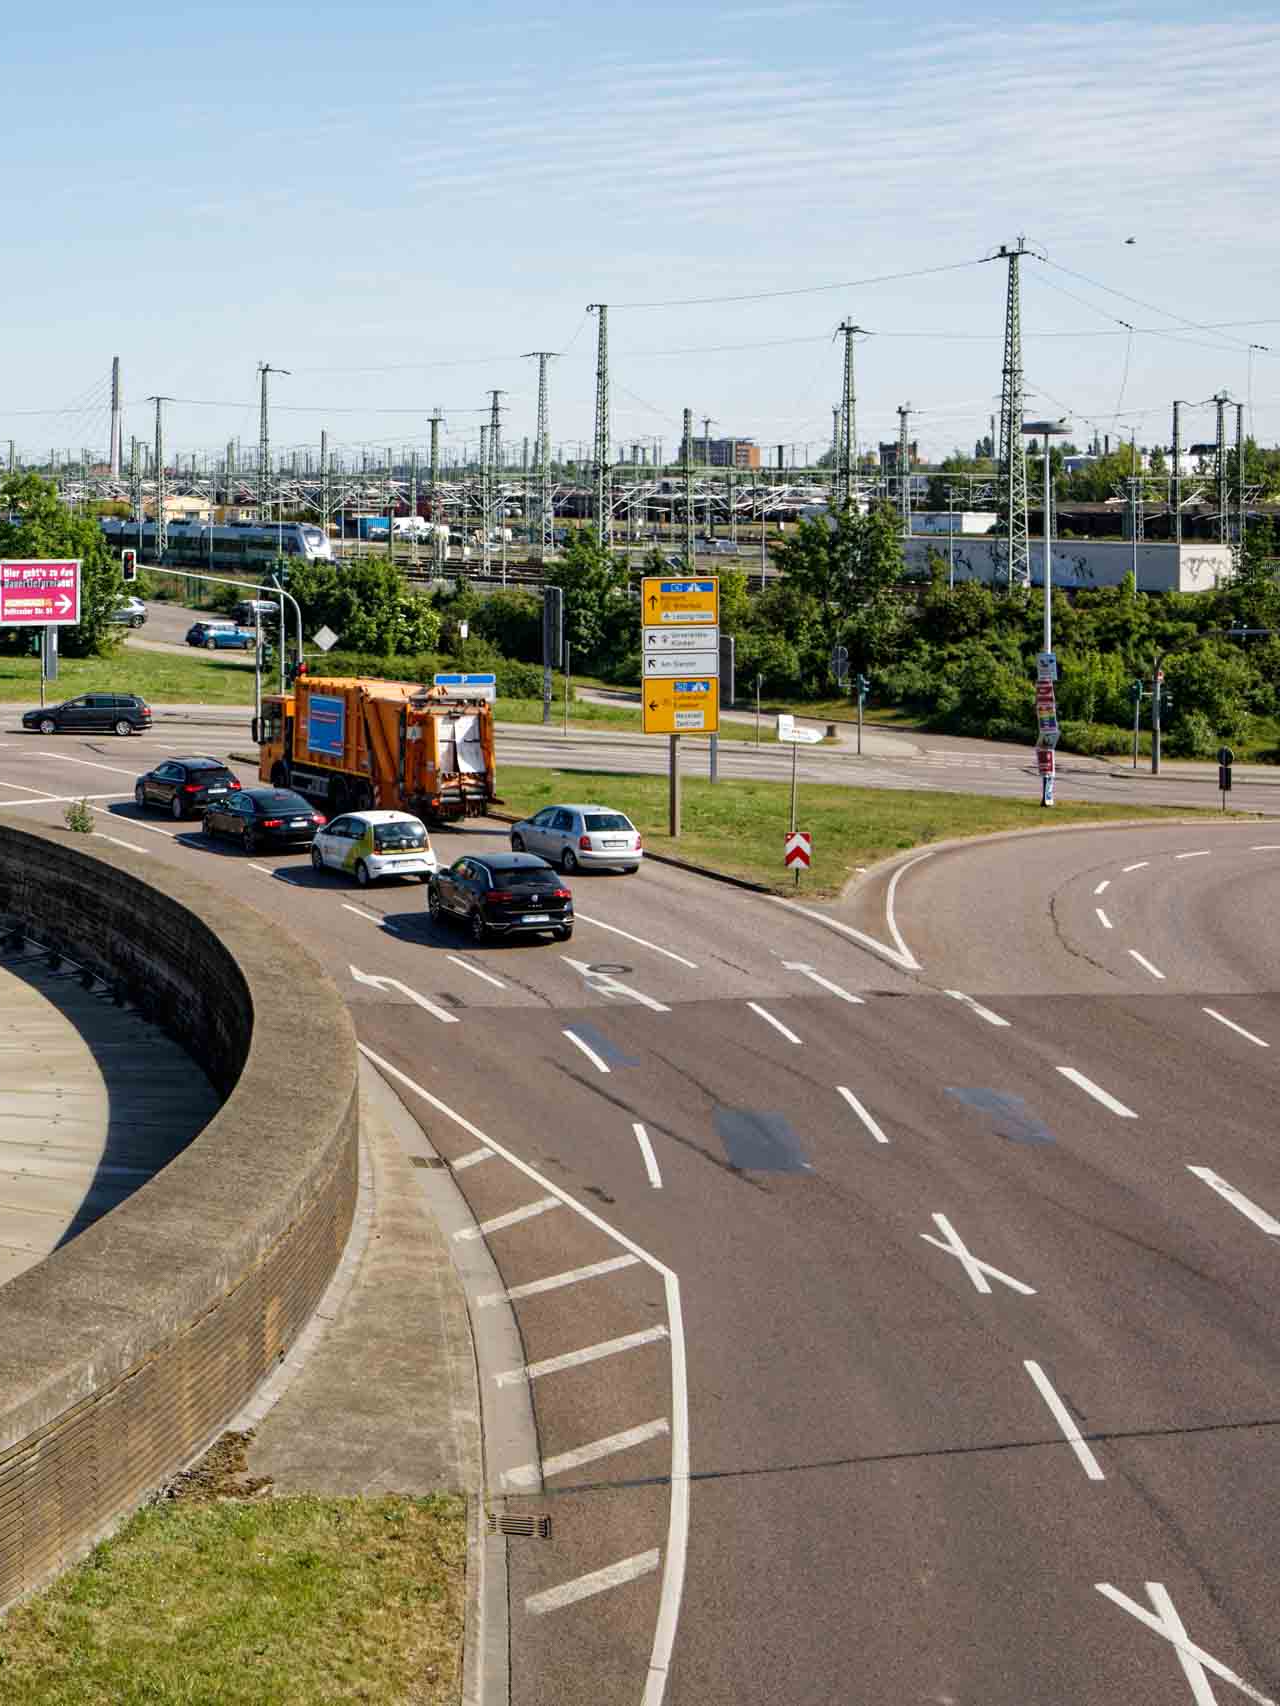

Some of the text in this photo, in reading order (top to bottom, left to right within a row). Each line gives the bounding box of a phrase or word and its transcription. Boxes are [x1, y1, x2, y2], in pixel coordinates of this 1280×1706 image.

[4, 567, 73, 579] Hier geht's zu den
